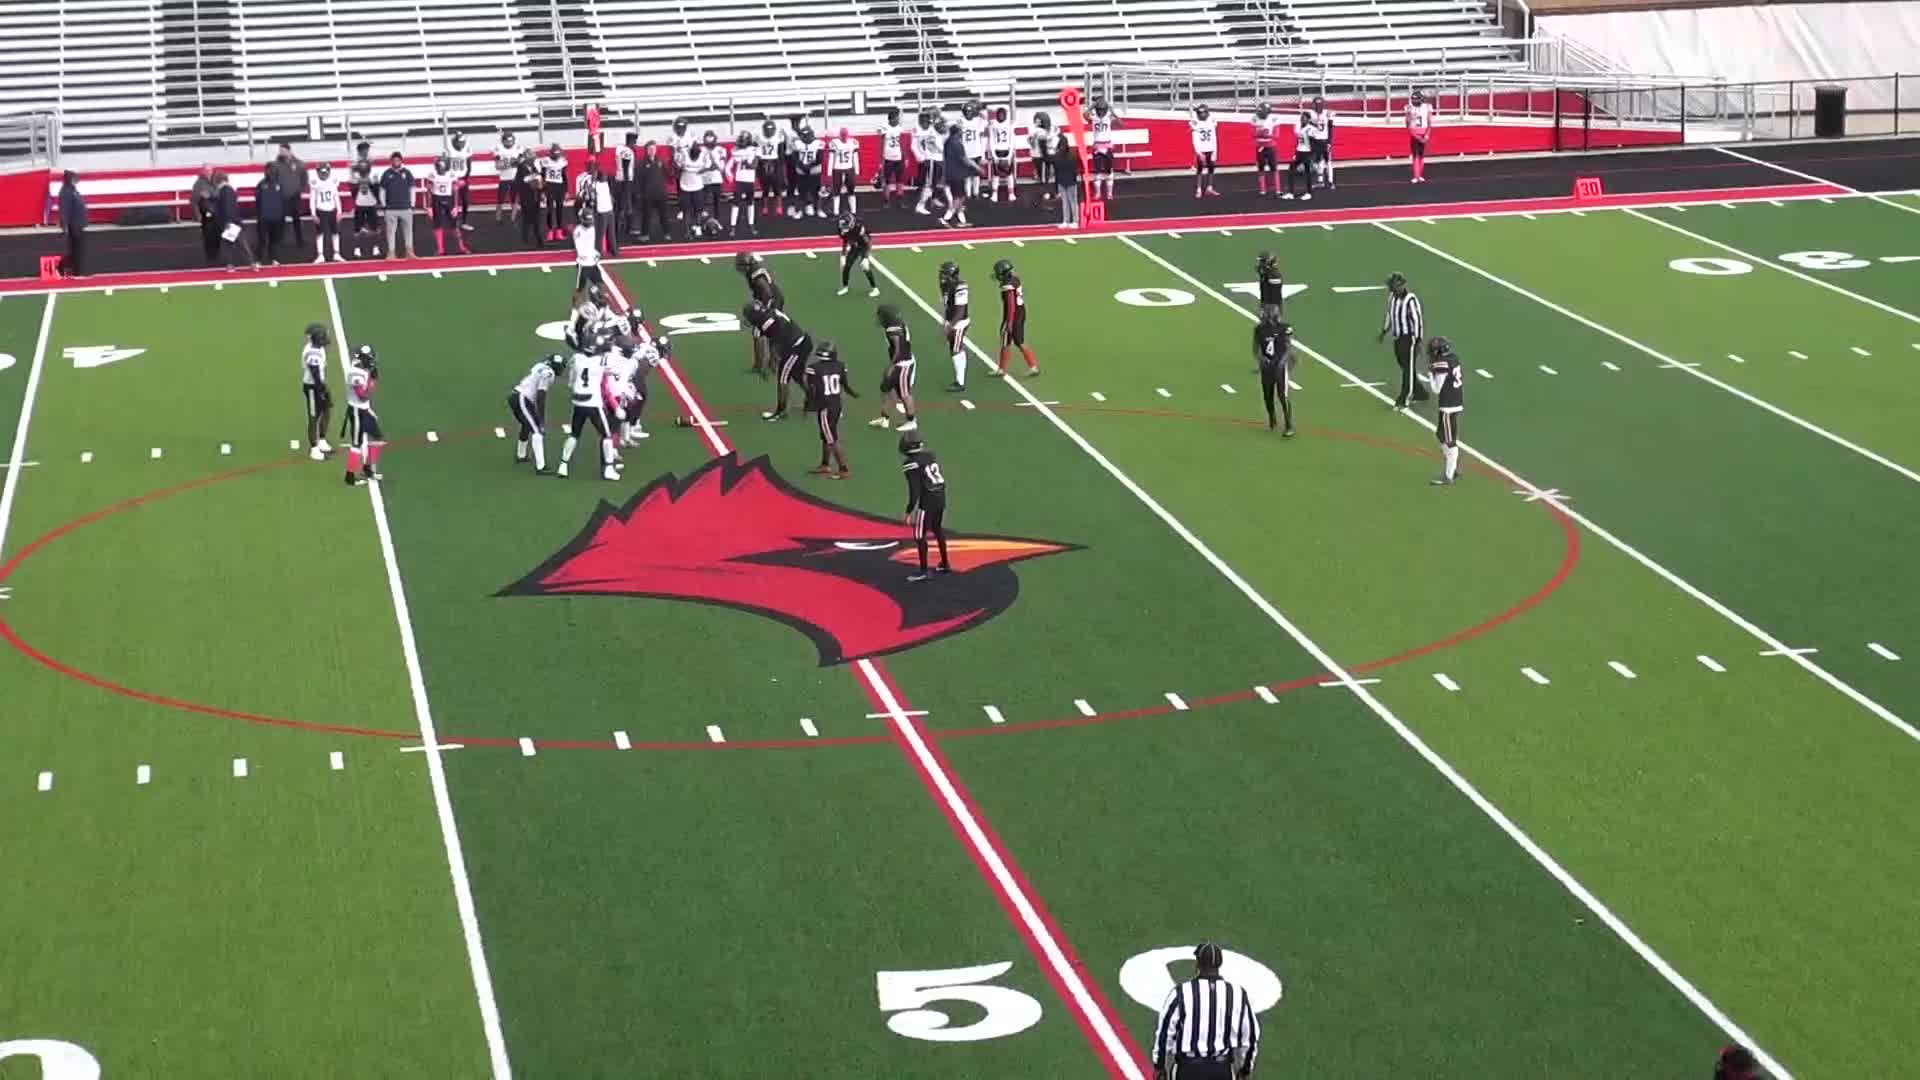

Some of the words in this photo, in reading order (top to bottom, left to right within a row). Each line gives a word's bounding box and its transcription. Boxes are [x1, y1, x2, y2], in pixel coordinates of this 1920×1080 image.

[320, 190, 332, 203] 10
[1580, 181, 1599, 196] 30
[580, 367, 589, 388] 4
[823, 373, 840, 396] 10
[925, 462, 945, 484] 13
